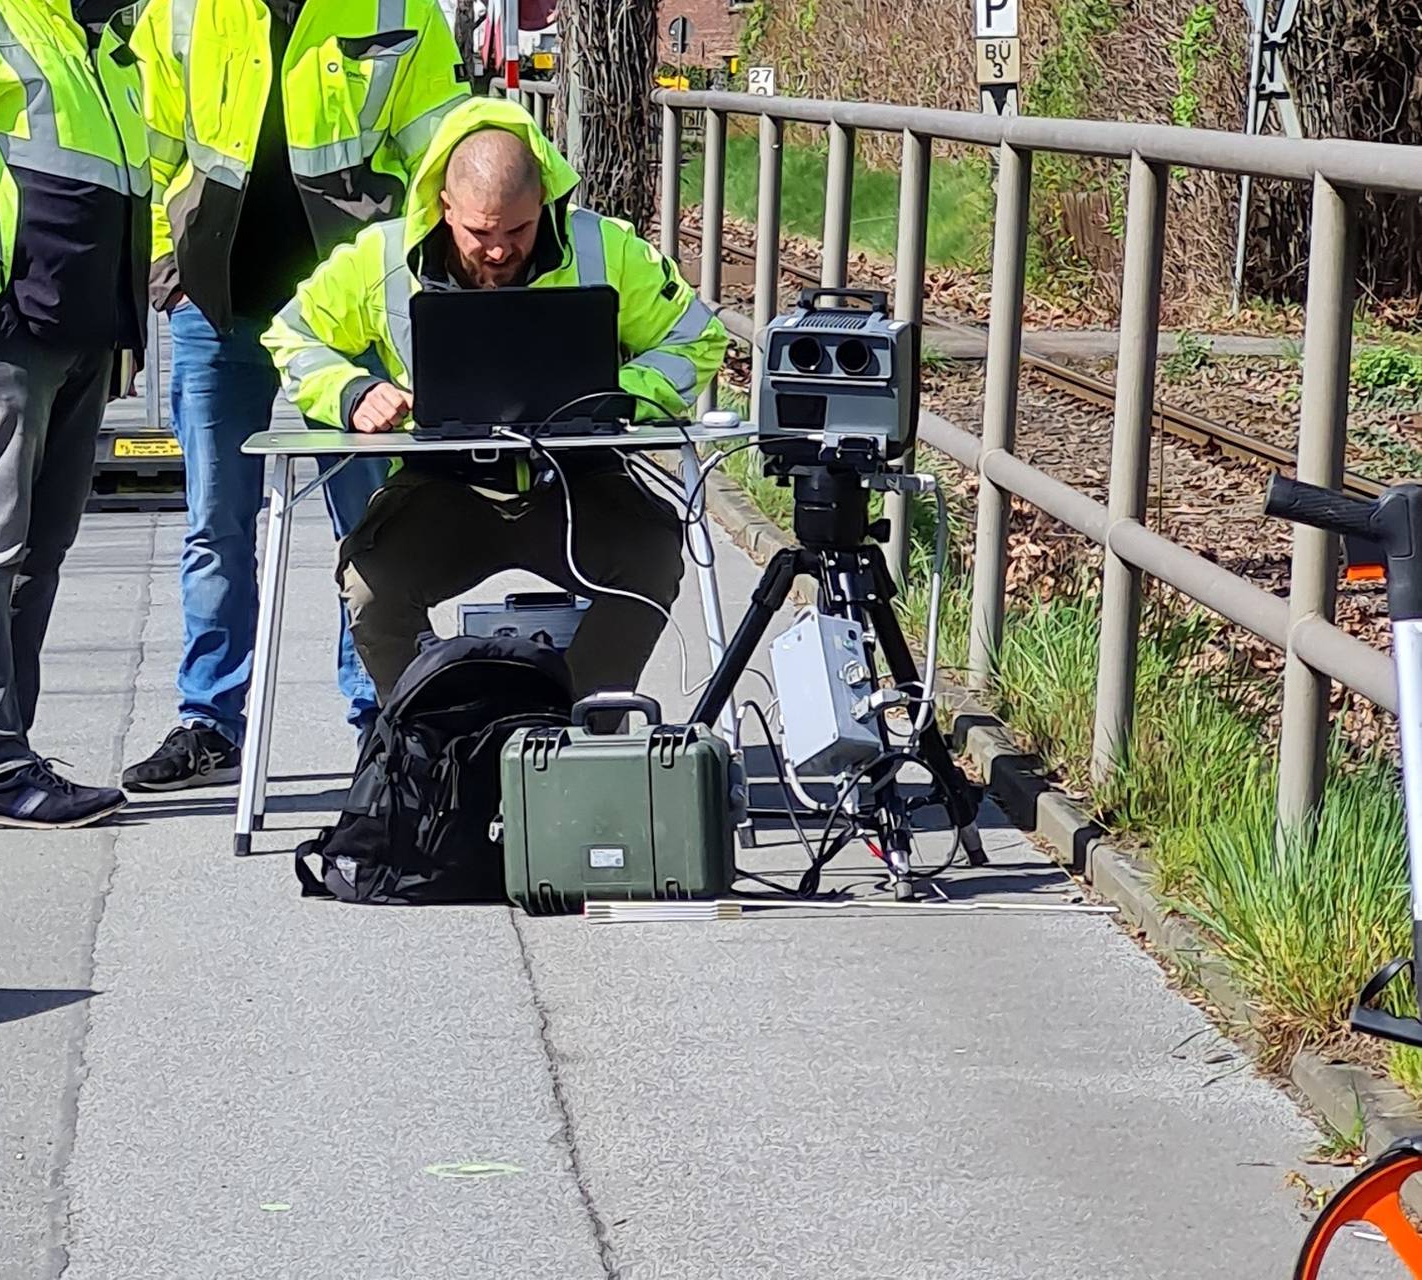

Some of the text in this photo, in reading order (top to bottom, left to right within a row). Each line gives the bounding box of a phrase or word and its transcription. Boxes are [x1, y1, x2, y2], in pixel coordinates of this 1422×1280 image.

[986, 40, 1011, 60] BÜ
[750, 69, 772, 83] 27
[993, 63, 1004, 79] 3
